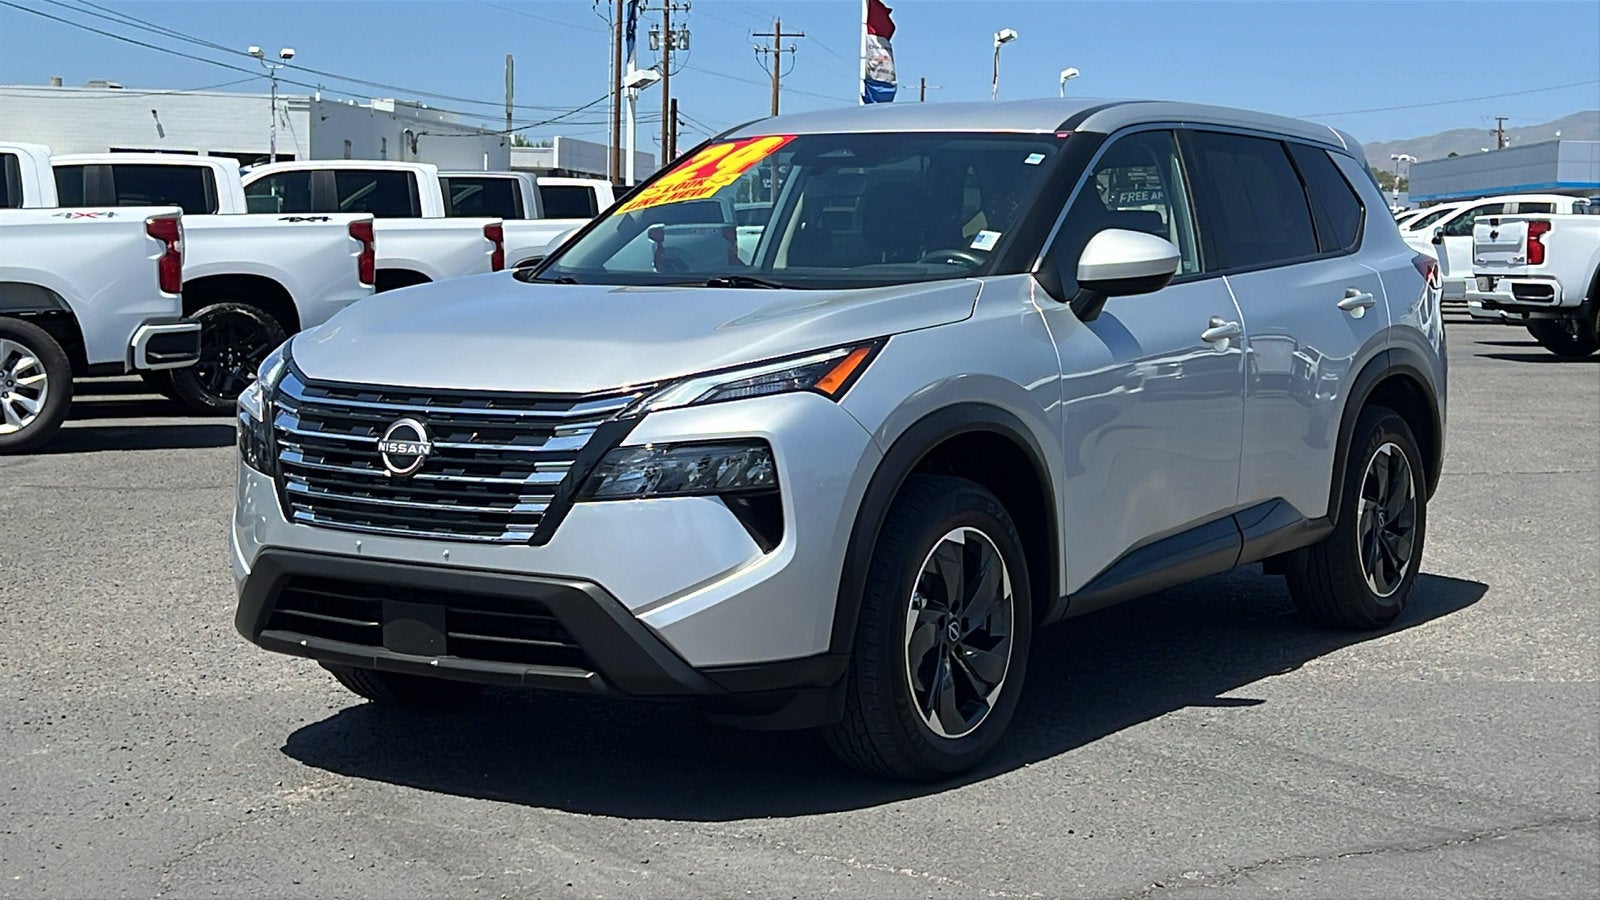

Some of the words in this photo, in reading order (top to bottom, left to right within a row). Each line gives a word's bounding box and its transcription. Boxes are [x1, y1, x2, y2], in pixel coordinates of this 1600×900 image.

[653, 137, 785, 187] 24
[662, 179, 707, 194] LOOK
[623, 194, 668, 212] LIKE
[1119, 191, 1149, 203] FREE
[377, 441, 432, 455] NISSAN
